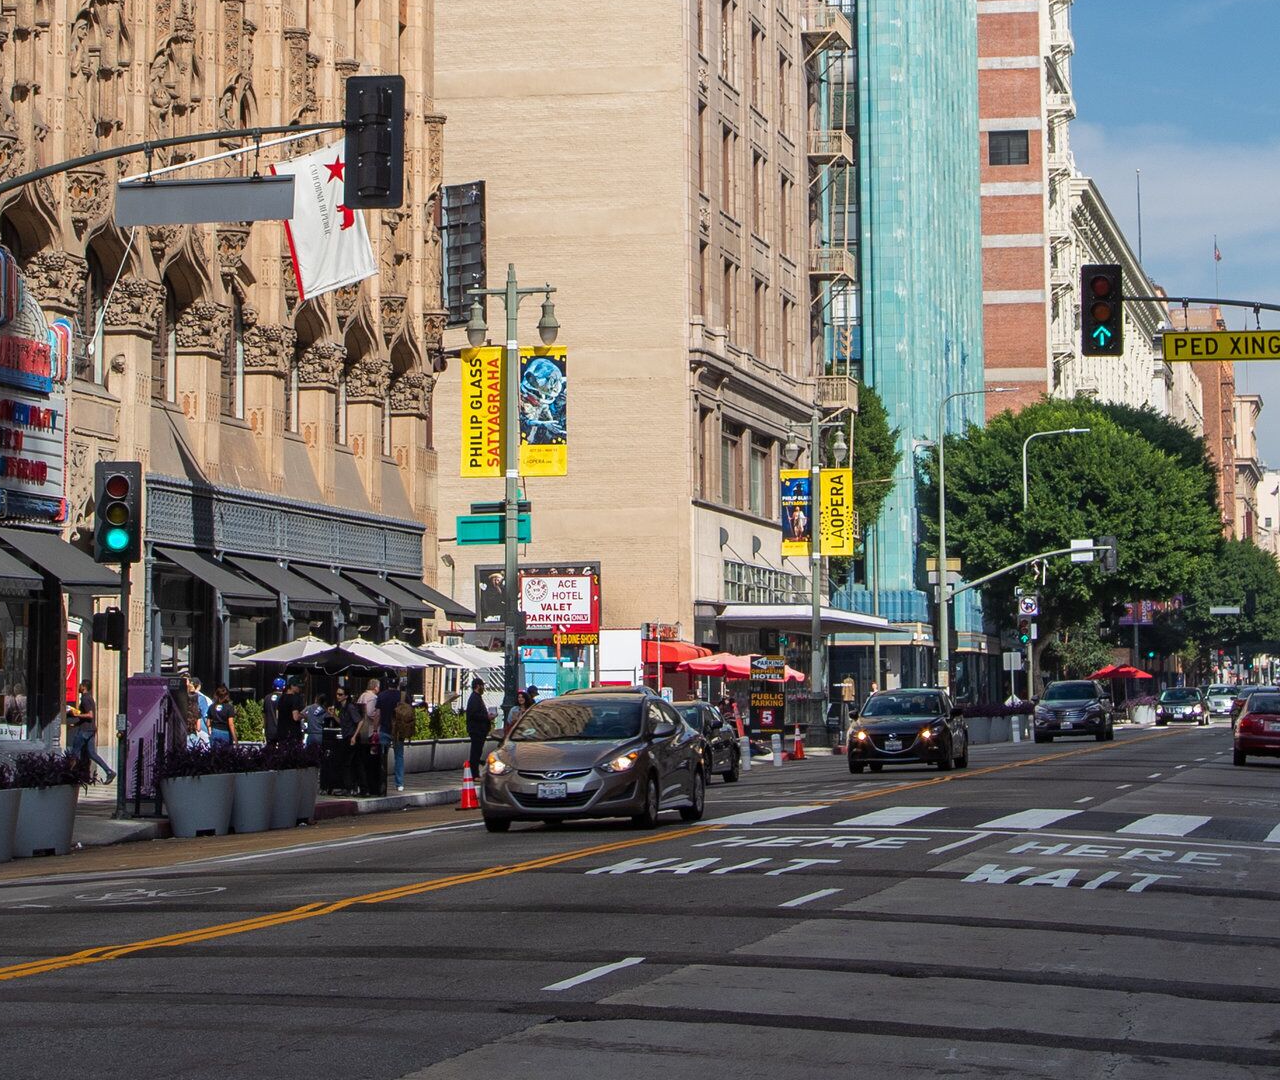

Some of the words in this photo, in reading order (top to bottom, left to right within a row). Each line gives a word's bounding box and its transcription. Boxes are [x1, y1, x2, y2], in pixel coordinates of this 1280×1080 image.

[1174, 337, 1219, 356] PED
[1230, 336, 1280, 355] XING
[470, 358, 482, 410] GLASS
[487, 358, 500, 467] SATYAGRAHA
[470, 415, 482, 468] PHILIP
[558, 580, 577, 588] ACE
[552, 592, 583, 600] HOTEL
[541, 603, 572, 611] VALET
[526, 614, 570, 622] PARKING
[572, 614, 588, 622] ONLY
[762, 710, 772, 722] 5
[691, 836, 931, 849] HERE
[1006, 841, 1232, 866] HERE
[585, 858, 842, 876] WAIT
[960, 864, 1183, 893] WAIT
